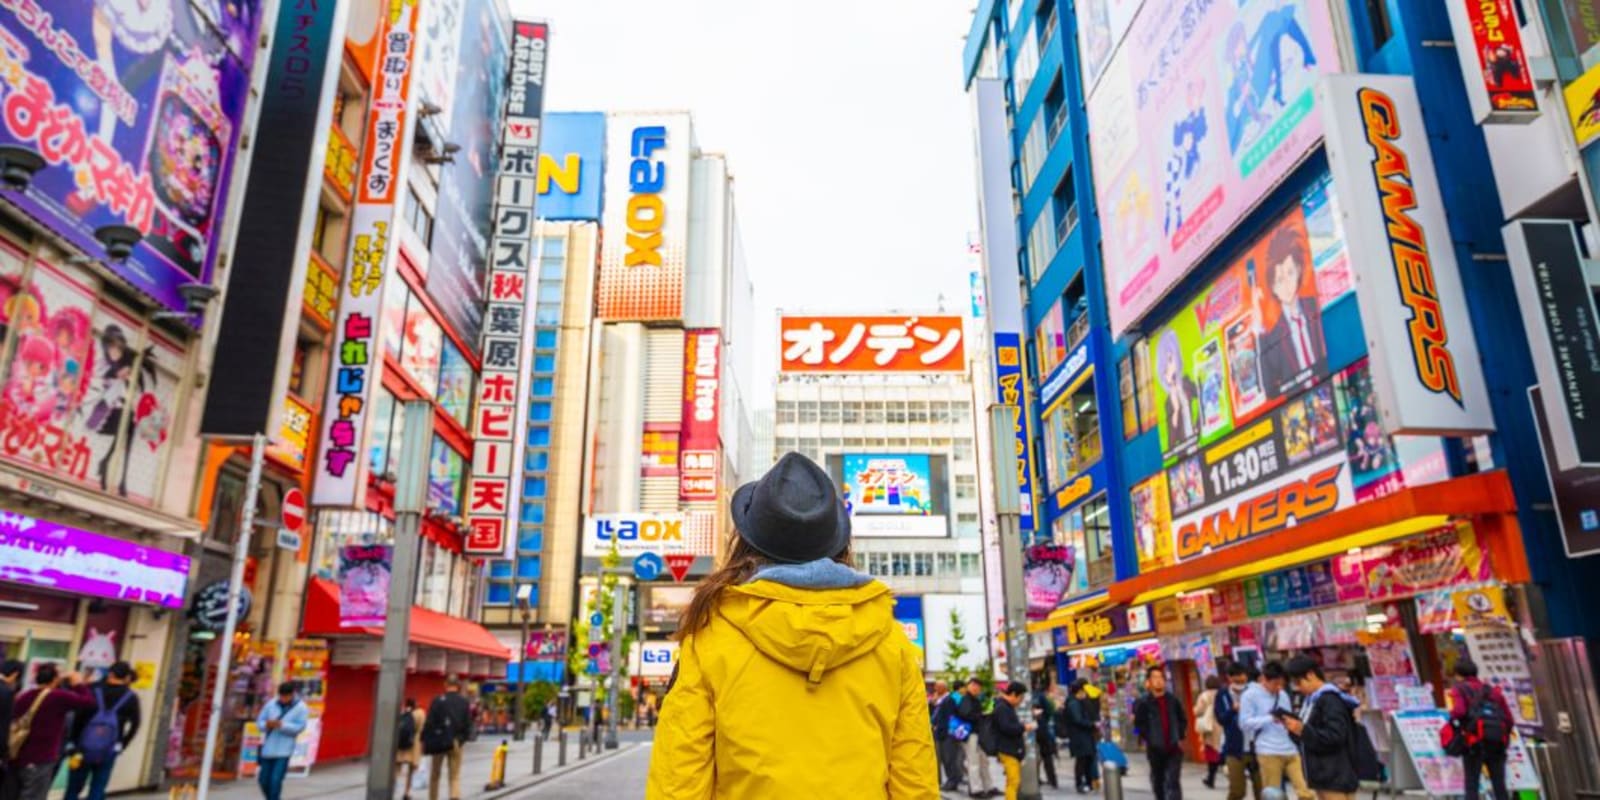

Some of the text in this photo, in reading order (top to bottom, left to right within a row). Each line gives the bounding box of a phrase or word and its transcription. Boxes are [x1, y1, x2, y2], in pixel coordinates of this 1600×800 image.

[1358, 87, 1464, 410] GAMERS
[783, 317, 961, 366] オノデン
[1538, 261, 1585, 420] ALIENWARE STORE AKIBA
[695, 379, 717, 421] Free
[1210, 447, 1260, 496] 11.30
[1177, 462, 1344, 560] GAMERS
